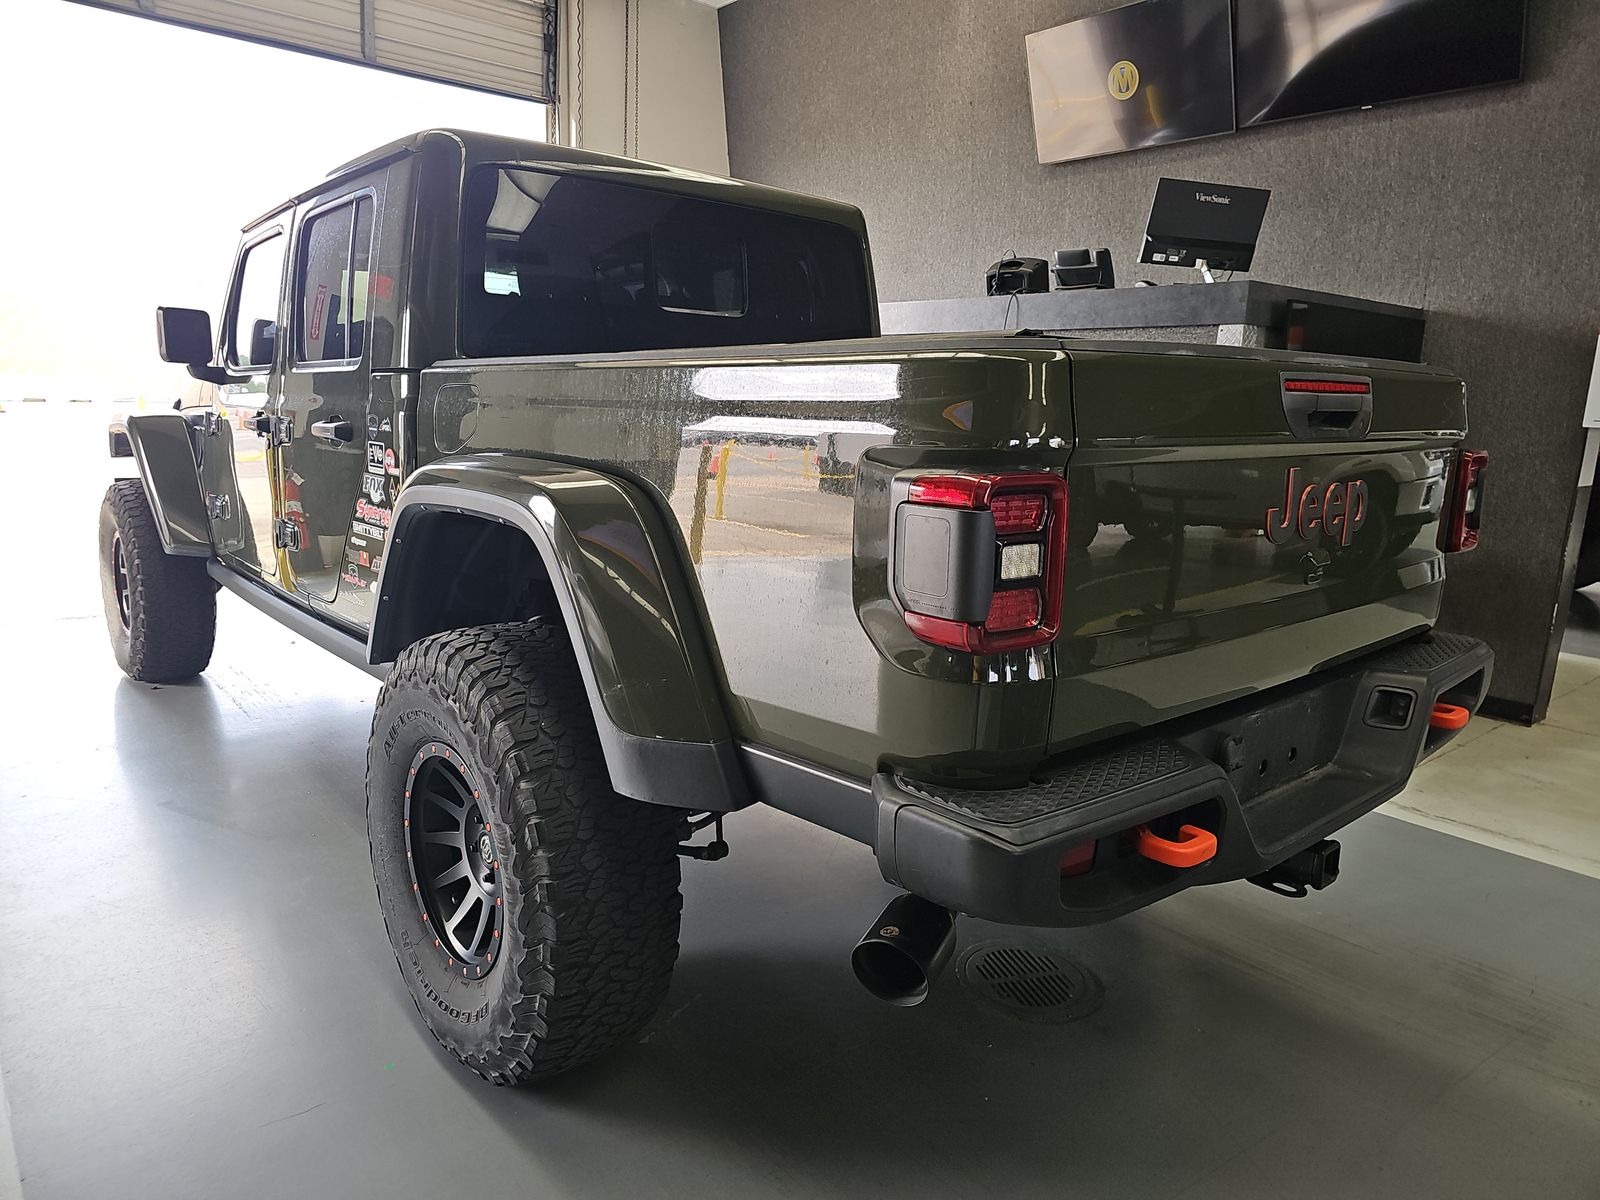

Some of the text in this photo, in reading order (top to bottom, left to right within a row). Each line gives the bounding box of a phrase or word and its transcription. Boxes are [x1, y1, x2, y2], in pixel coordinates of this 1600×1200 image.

[1195, 192, 1231, 205] ViewSonic
[363, 475, 384, 494] FOX
[355, 498, 392, 528] Synergy
[1265, 467, 1369, 547] Jeep
